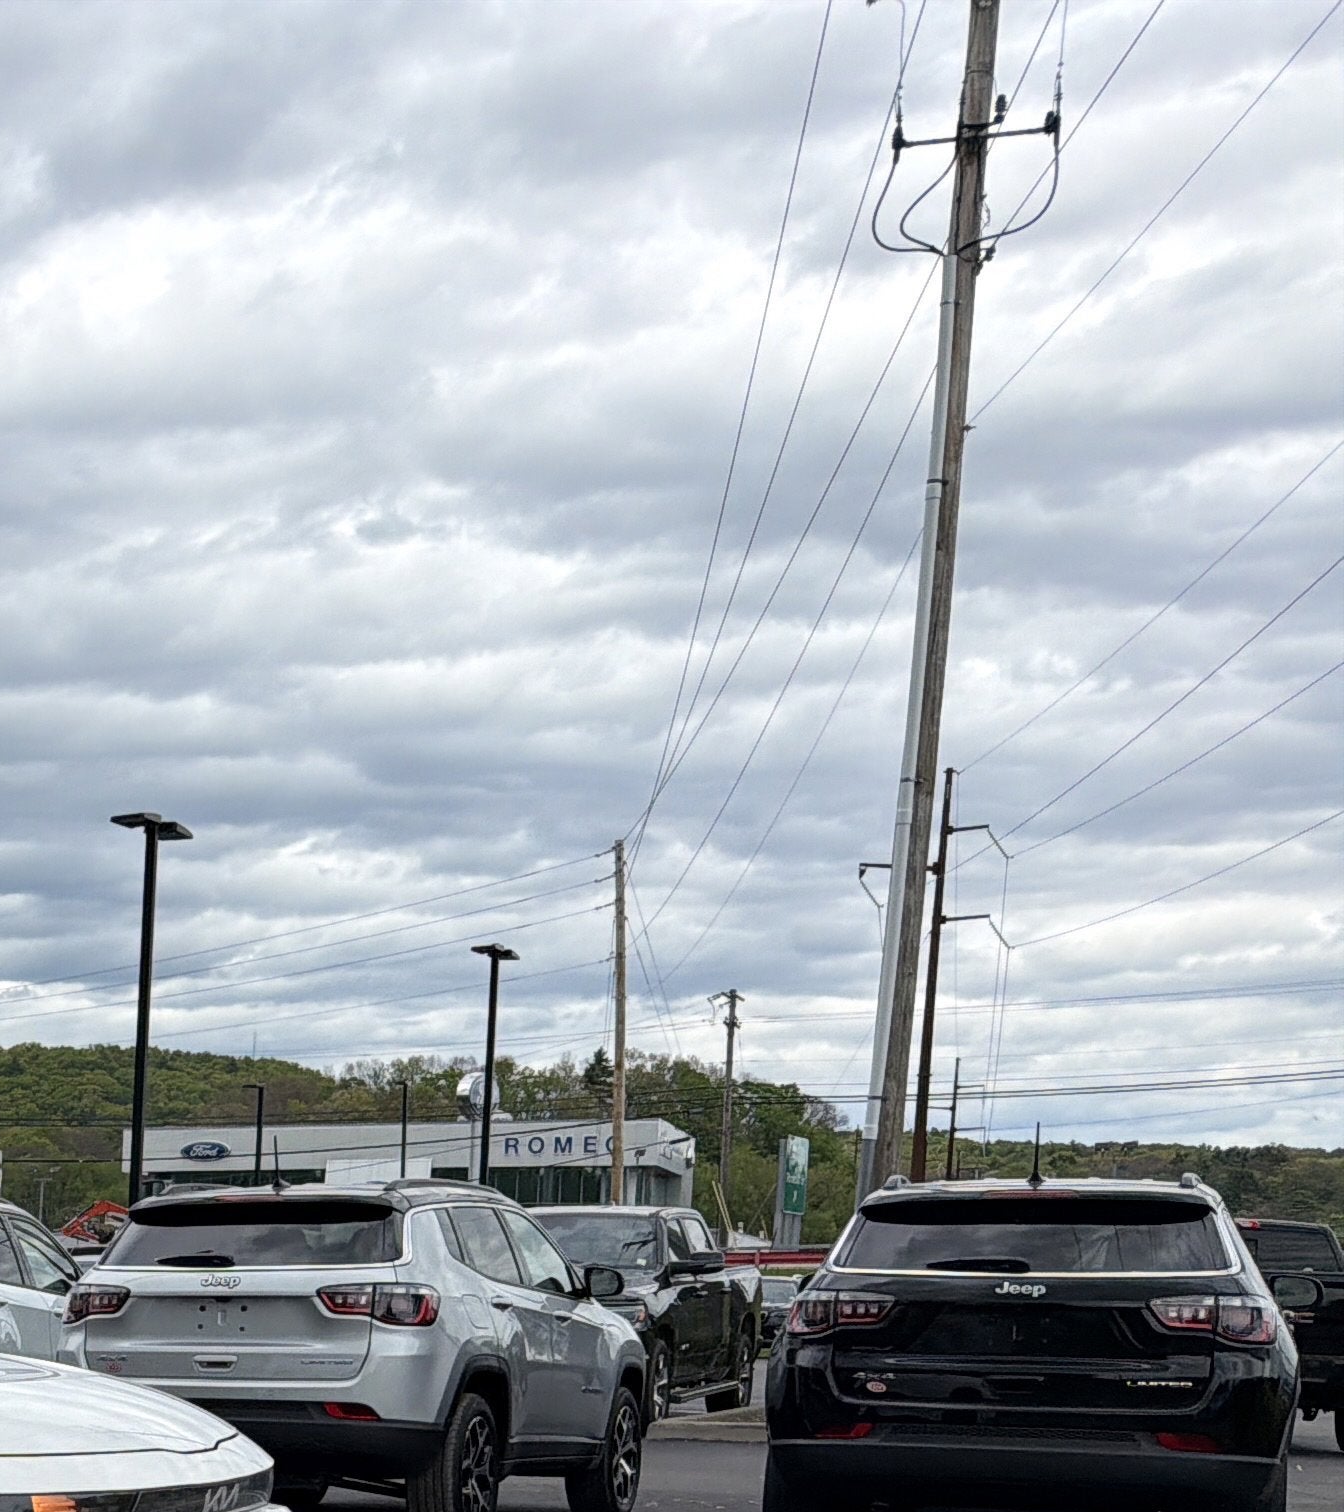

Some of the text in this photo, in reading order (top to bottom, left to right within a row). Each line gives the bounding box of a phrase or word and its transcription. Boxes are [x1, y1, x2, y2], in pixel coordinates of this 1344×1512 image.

[189, 1144, 220, 1157] Ford
[200, 1273, 242, 1289] Jeep
[994, 1281, 1047, 1298] Jeep
